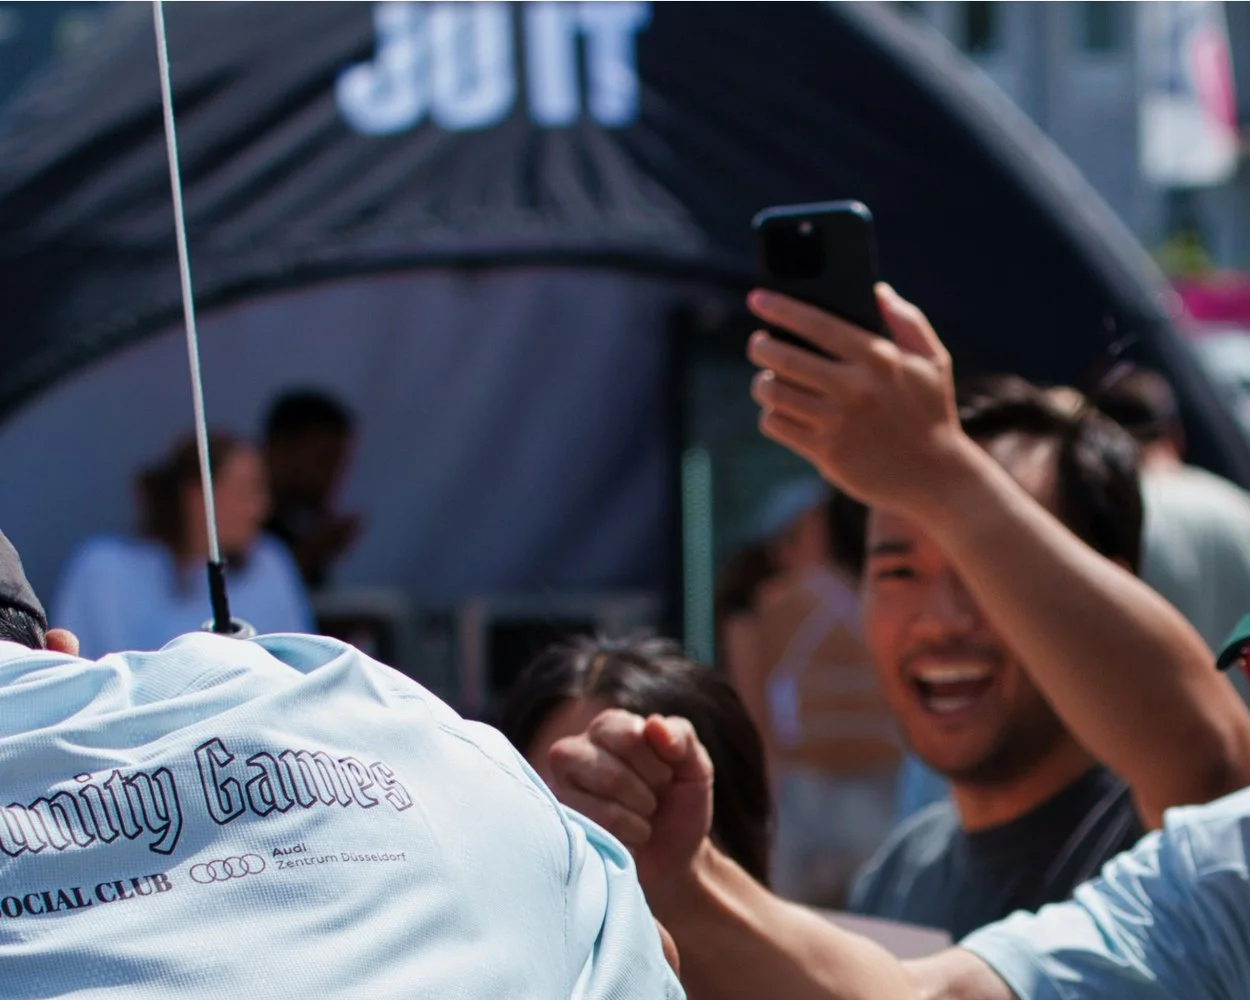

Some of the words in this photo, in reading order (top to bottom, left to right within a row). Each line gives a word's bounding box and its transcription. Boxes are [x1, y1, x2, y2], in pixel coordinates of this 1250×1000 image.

[194, 737, 414, 825] Games
[272, 842, 308, 858] Audi
[275, 854, 339, 870] Zentrum
[340, 851, 407, 863] Düsseldorf
[0, 886, 93, 919] OCIAL
[95, 872, 174, 904] CLUB
